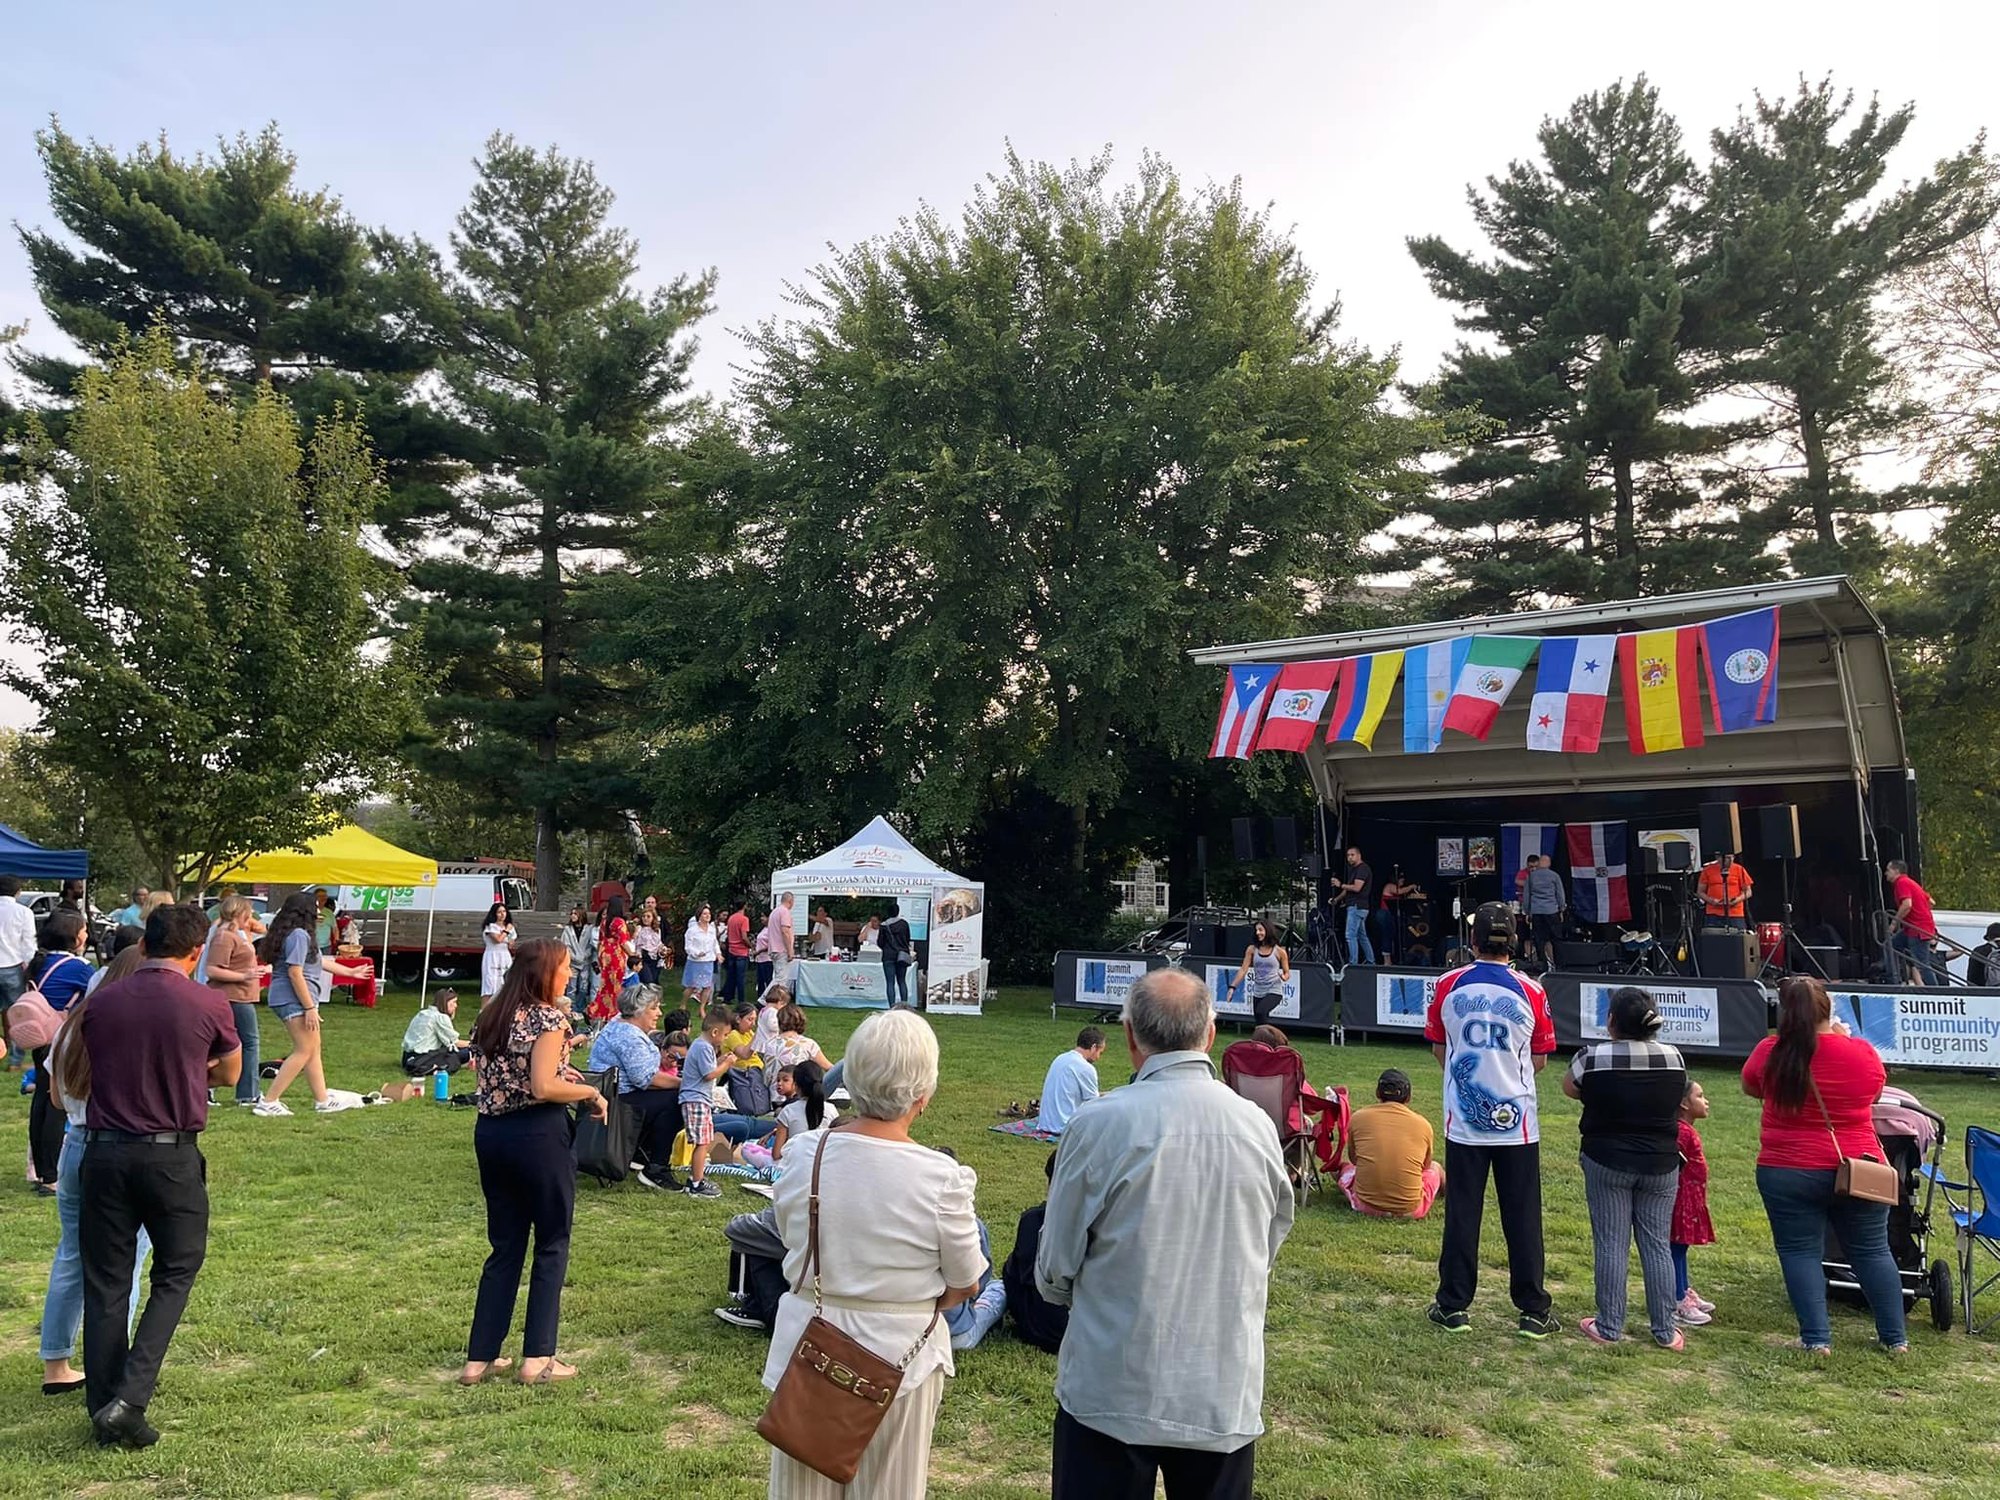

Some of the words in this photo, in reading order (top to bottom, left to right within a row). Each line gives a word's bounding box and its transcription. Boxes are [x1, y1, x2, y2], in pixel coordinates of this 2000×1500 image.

[796, 875, 859, 884] EMPANADAS
[862, 876, 884, 884] AND
[1107, 963, 1131, 974] summit
[1658, 1004, 1711, 1021] mmunity
[1900, 998, 1966, 1015] summit
[1663, 1019, 1702, 1033] grams
[1901, 1016, 2000, 1038] community
[1462, 1019, 1511, 1051] CR
[1902, 1035, 1989, 1055] programs
